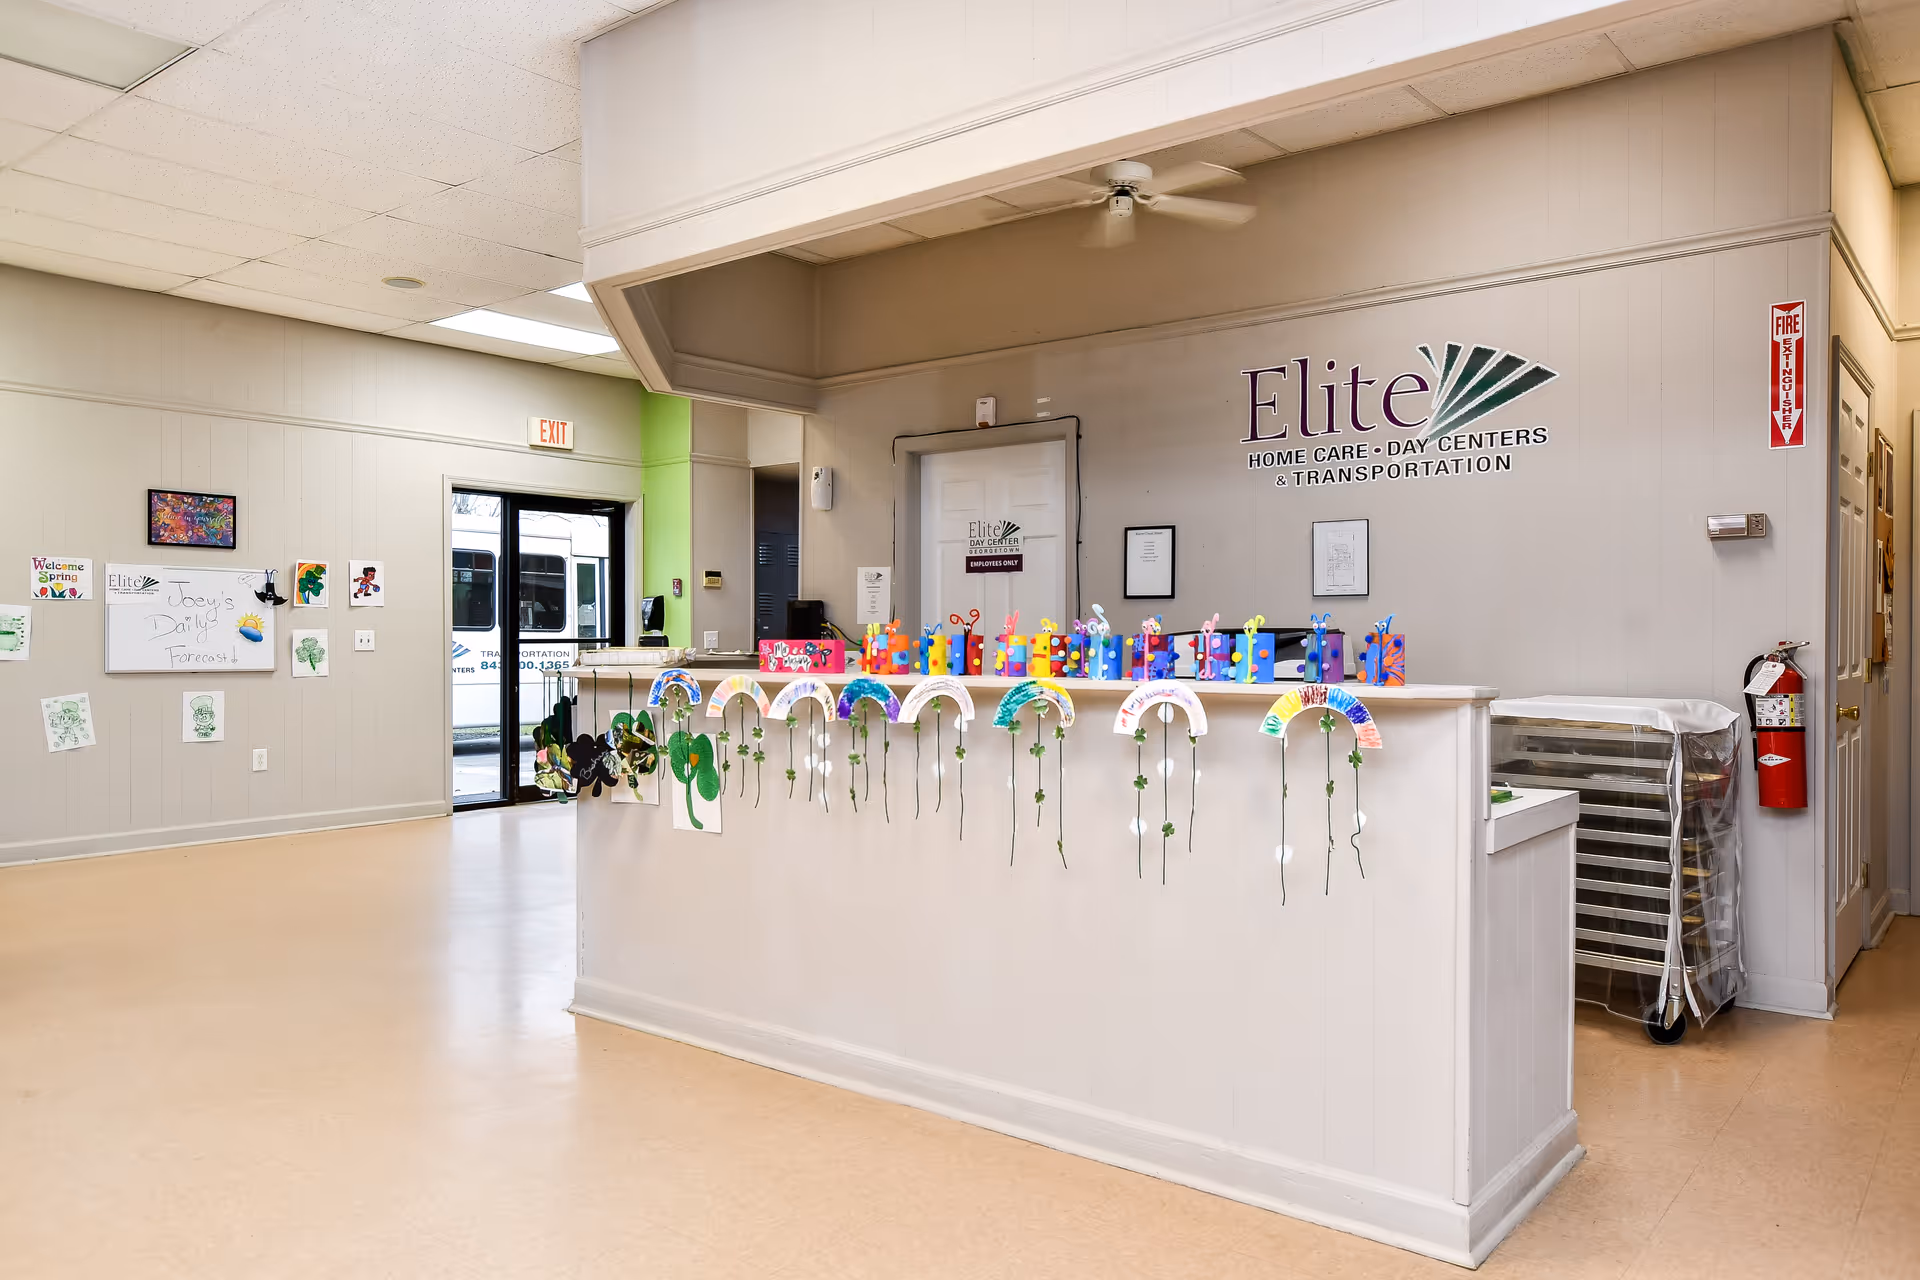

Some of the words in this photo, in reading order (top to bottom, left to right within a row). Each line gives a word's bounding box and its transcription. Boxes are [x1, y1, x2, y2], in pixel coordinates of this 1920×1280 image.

[1775, 313, 1800, 336] FIRE
[1781, 338, 1793, 430] EXTINGUISHER
[1241, 356, 1430, 442] Elite
[540, 419, 567, 445] EXIT
[1248, 449, 1306, 469] HOME
[1313, 443, 1368, 463] CARE
[1387, 437, 1429, 456] DAY
[1438, 427, 1548, 452] CENTERS
[1275, 475, 1288, 486] &
[1292, 454, 1511, 486] TRANSPORTATION
[968, 520, 1001, 538] Elite
[968, 547, 1020, 555] GEORGETOWN
[987, 537, 1019, 546] CENTER
[32, 557, 84, 571] Welcome
[38, 571, 78, 584] Spring
[109, 573, 141, 588] Elite
[167, 580, 235, 623] Joey's
[144, 613, 219, 643] Daily
[480, 661, 570, 670] 8400.1365
